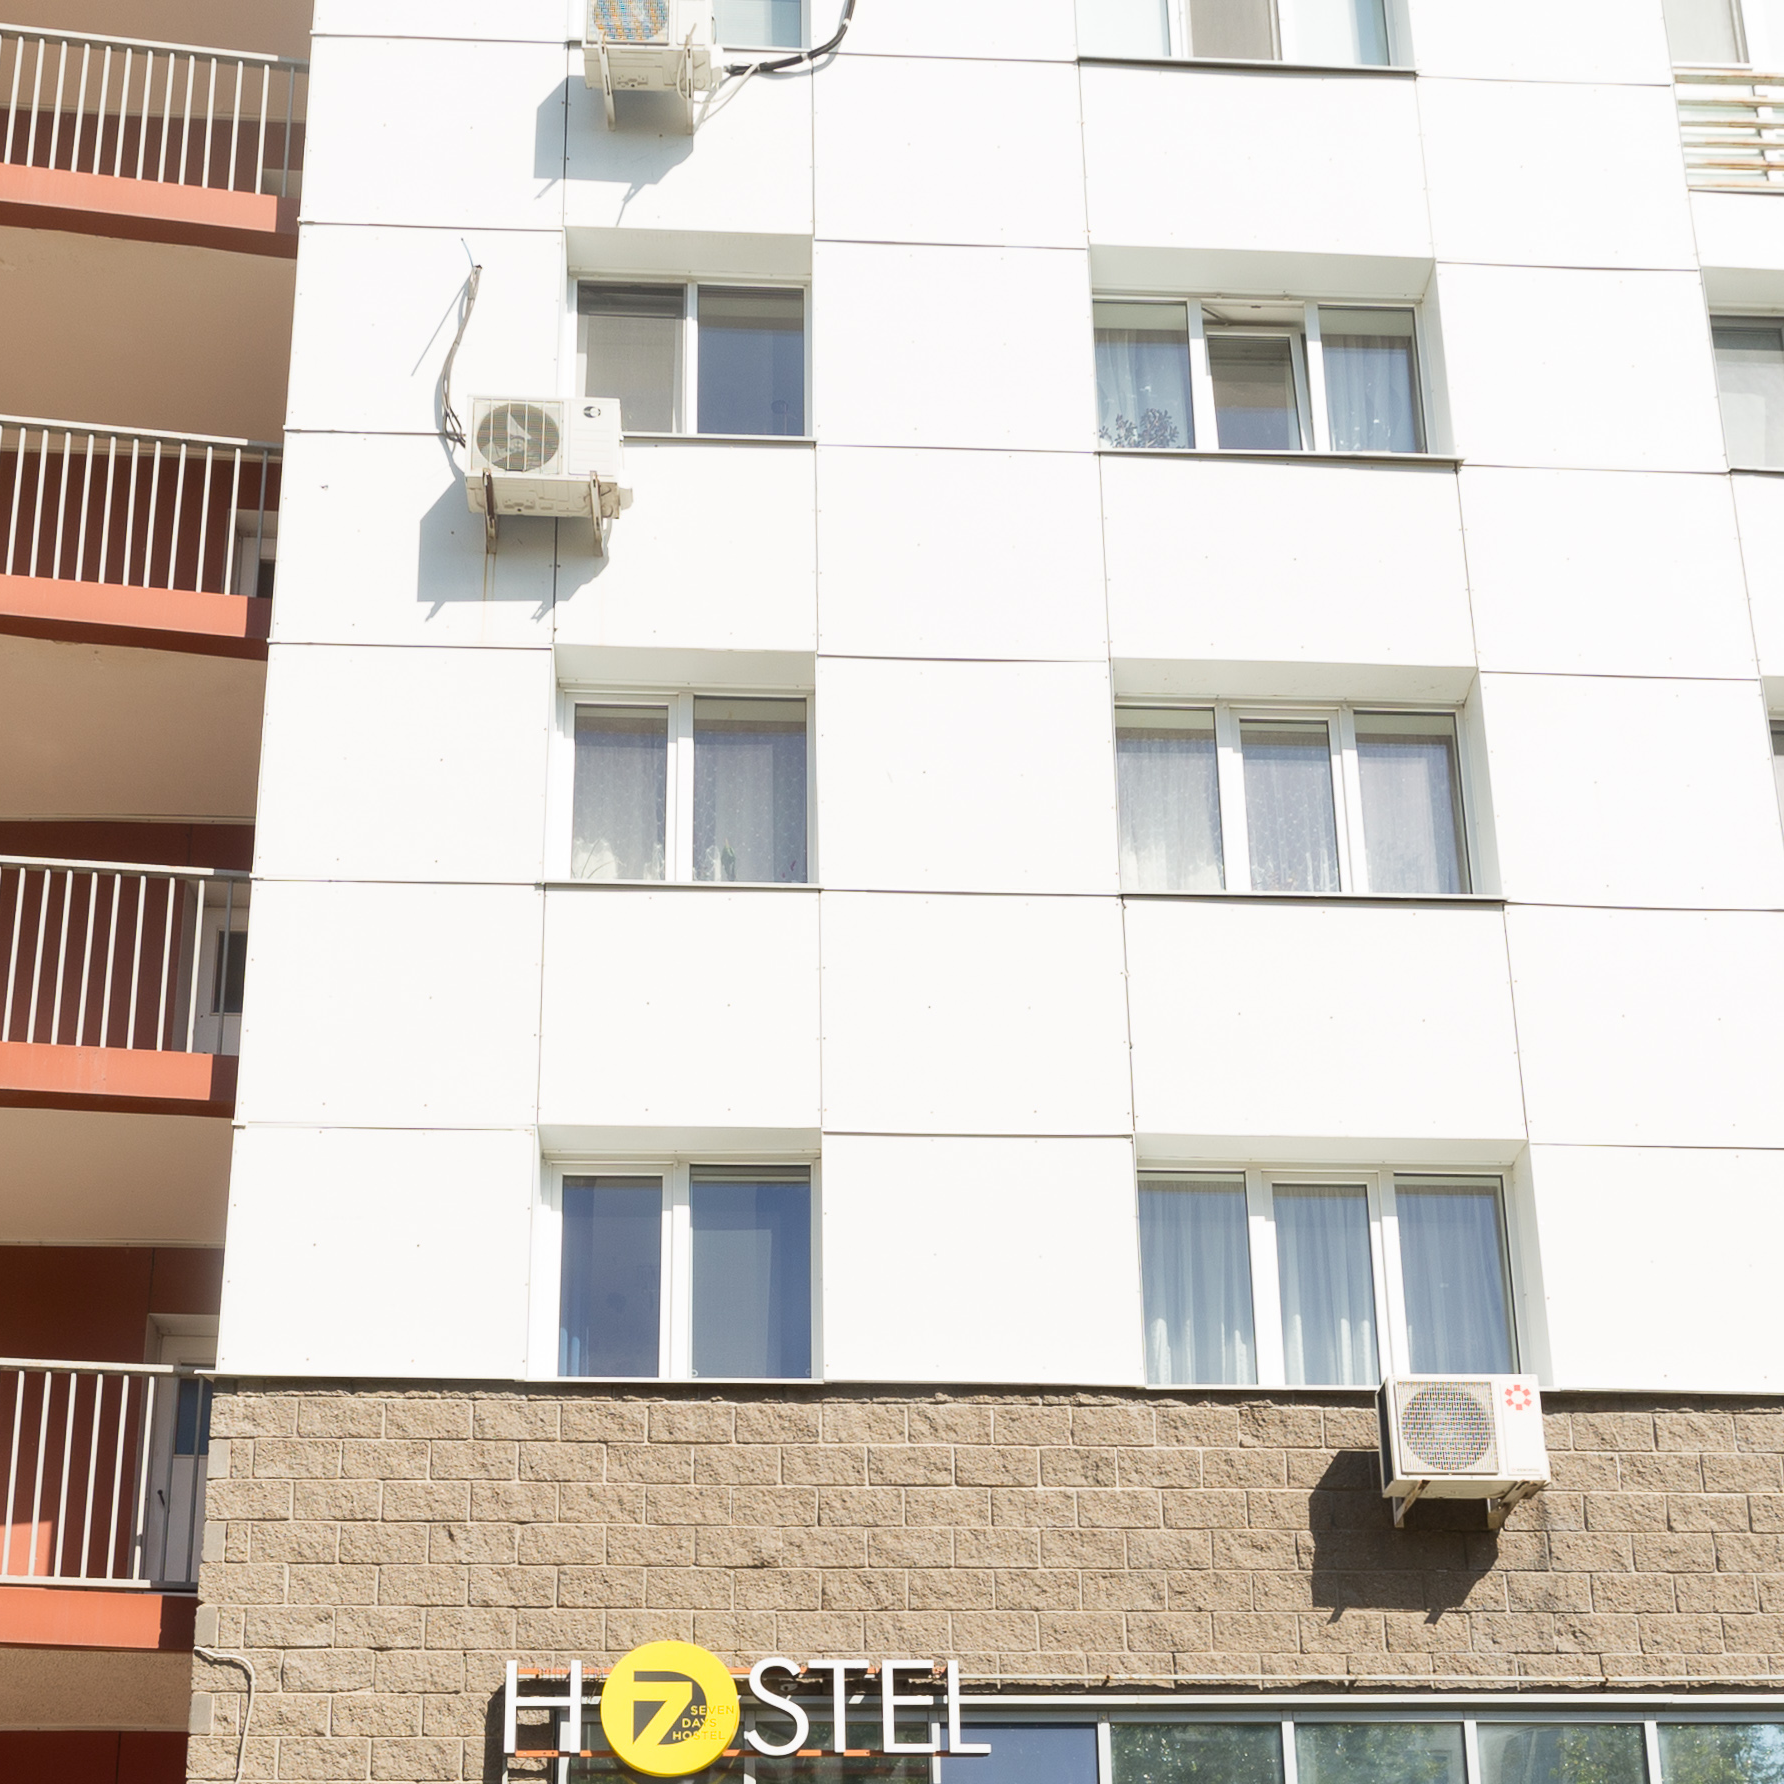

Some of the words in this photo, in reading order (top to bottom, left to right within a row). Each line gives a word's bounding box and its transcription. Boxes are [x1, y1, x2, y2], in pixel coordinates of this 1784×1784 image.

[690, 1705, 735, 1716] SEVEN
[681, 1718, 717, 1729] DAYS
[672, 1730, 726, 1741] HOSTEL
